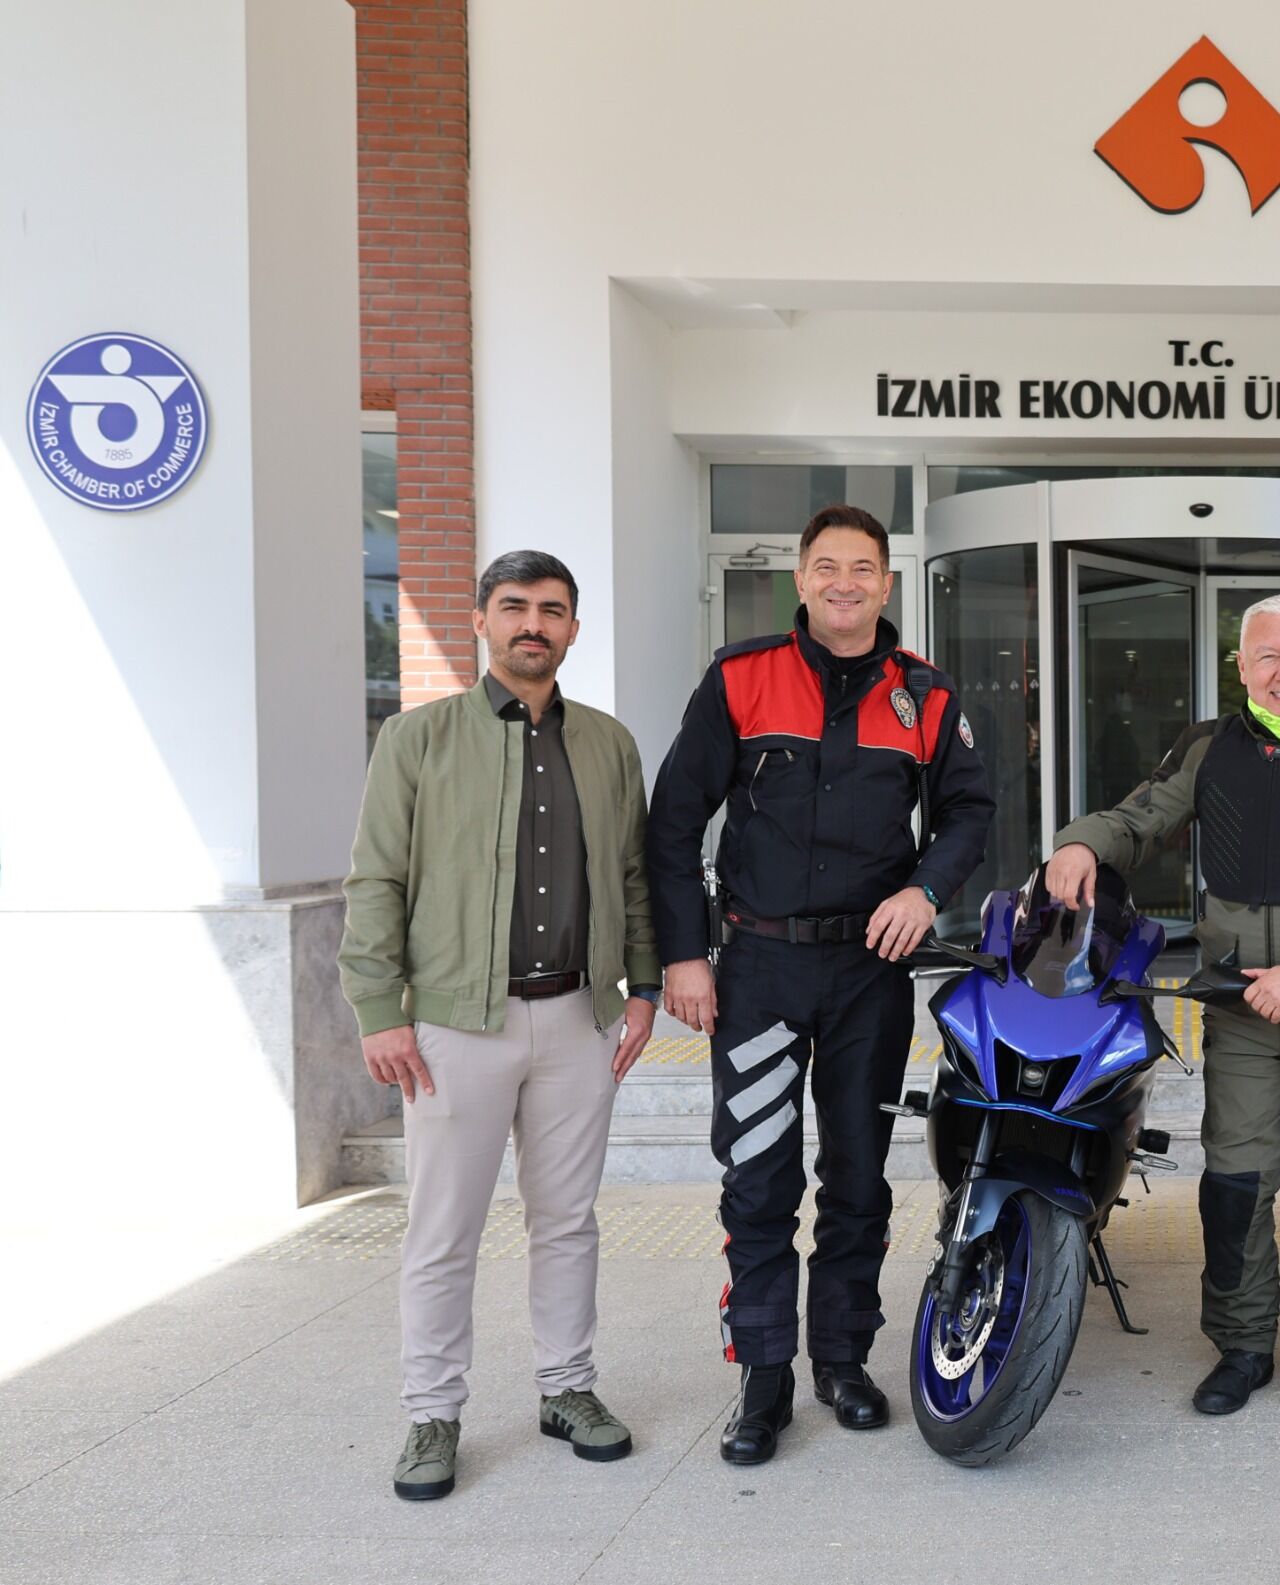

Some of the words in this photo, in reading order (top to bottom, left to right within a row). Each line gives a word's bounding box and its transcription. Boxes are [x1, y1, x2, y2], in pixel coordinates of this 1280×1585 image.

[1168, 340, 1234, 367] T.C.
[876, 373, 1002, 420] İZMİR
[1018, 375, 1227, 421] EKONOMİ
[39, 401, 60, 449] İZMİR
[148, 403, 193, 488] COMMERCE
[49, 449, 121, 499] CHAMBER
[104, 448, 134, 461] 1885
[123, 479, 147, 499] OF
